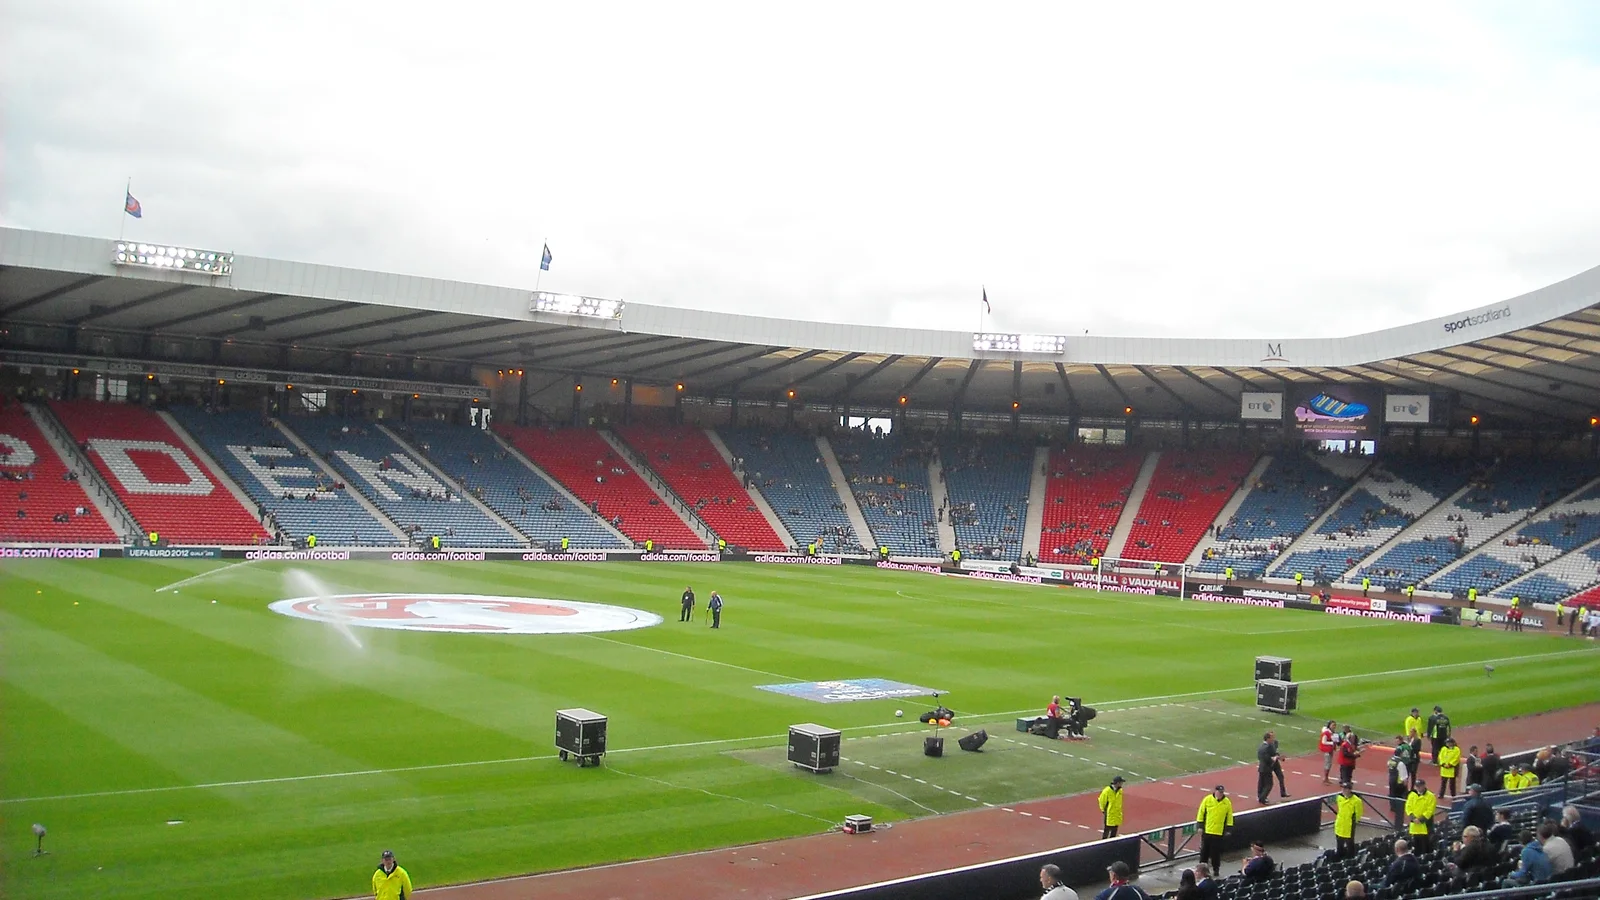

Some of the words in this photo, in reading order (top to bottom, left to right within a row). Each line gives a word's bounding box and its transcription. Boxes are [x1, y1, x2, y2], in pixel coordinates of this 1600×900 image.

[1444, 306, 1511, 333] sportscotland
[1267, 343, 1282, 357] M
[1248, 402, 1261, 410] BT
[1393, 405, 1407, 413] BT
[171, 549, 189, 557] 2012
[246, 550, 350, 560] adidas.com/football
[392, 552, 485, 561] adidas.com/football
[522, 553, 607, 561] adidas.com/football
[641, 553, 721, 562] adidas.com/football
[755, 555, 842, 565] adidas.com/football
[877, 561, 941, 574] adidas.com/football
[1129, 578, 1179, 590] VAUXHALL
[1325, 606, 1431, 624] adidas.com/football
[1492, 614, 1504, 622] ON
